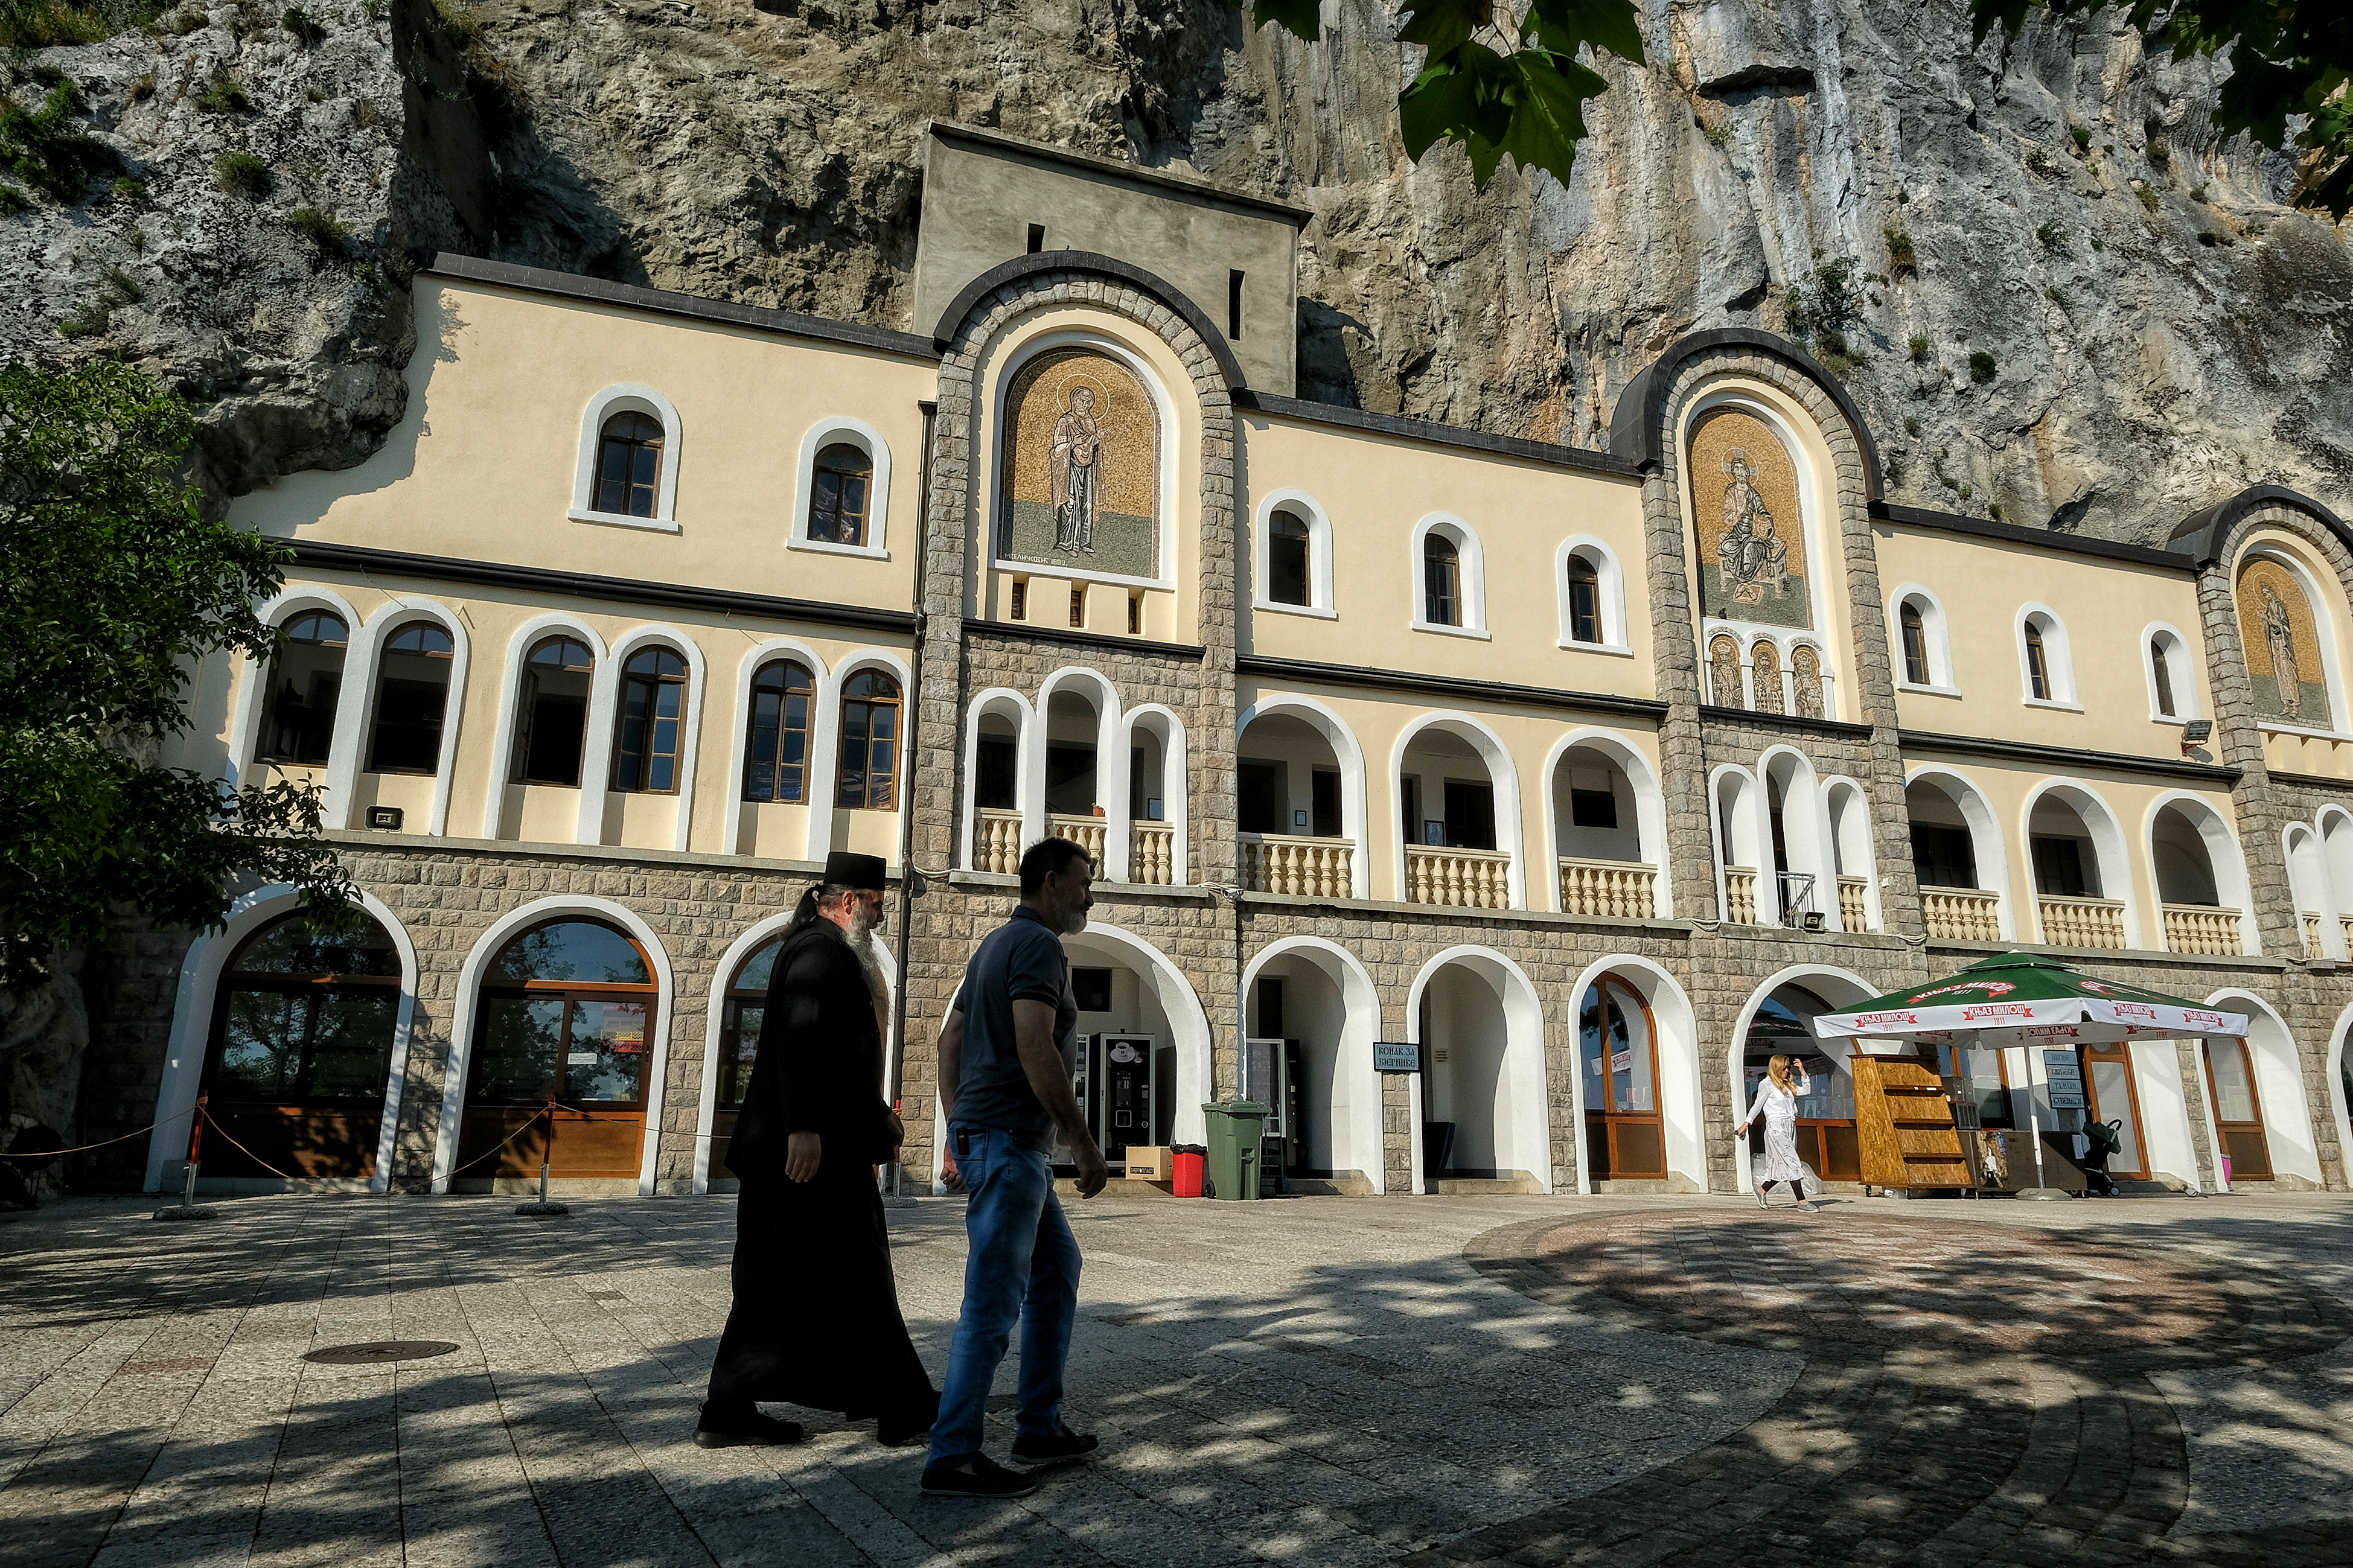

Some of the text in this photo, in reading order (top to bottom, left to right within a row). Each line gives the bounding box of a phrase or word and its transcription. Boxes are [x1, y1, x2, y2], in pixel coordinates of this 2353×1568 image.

[1916, 981, 2014, 999] КЊАЗ МИЛОШ
[1969, 1004, 2025, 1016] КЊАЗ МИЛОШ
[1859, 1012, 1910, 1024] КЊАЗ МИЛОШ
[1993, 1017, 2005, 1025] 1811
[1378, 1047, 1415, 1056] КОНАК ЗА
[1379, 1058, 1416, 1067] ВЈЕРНИКЕ
